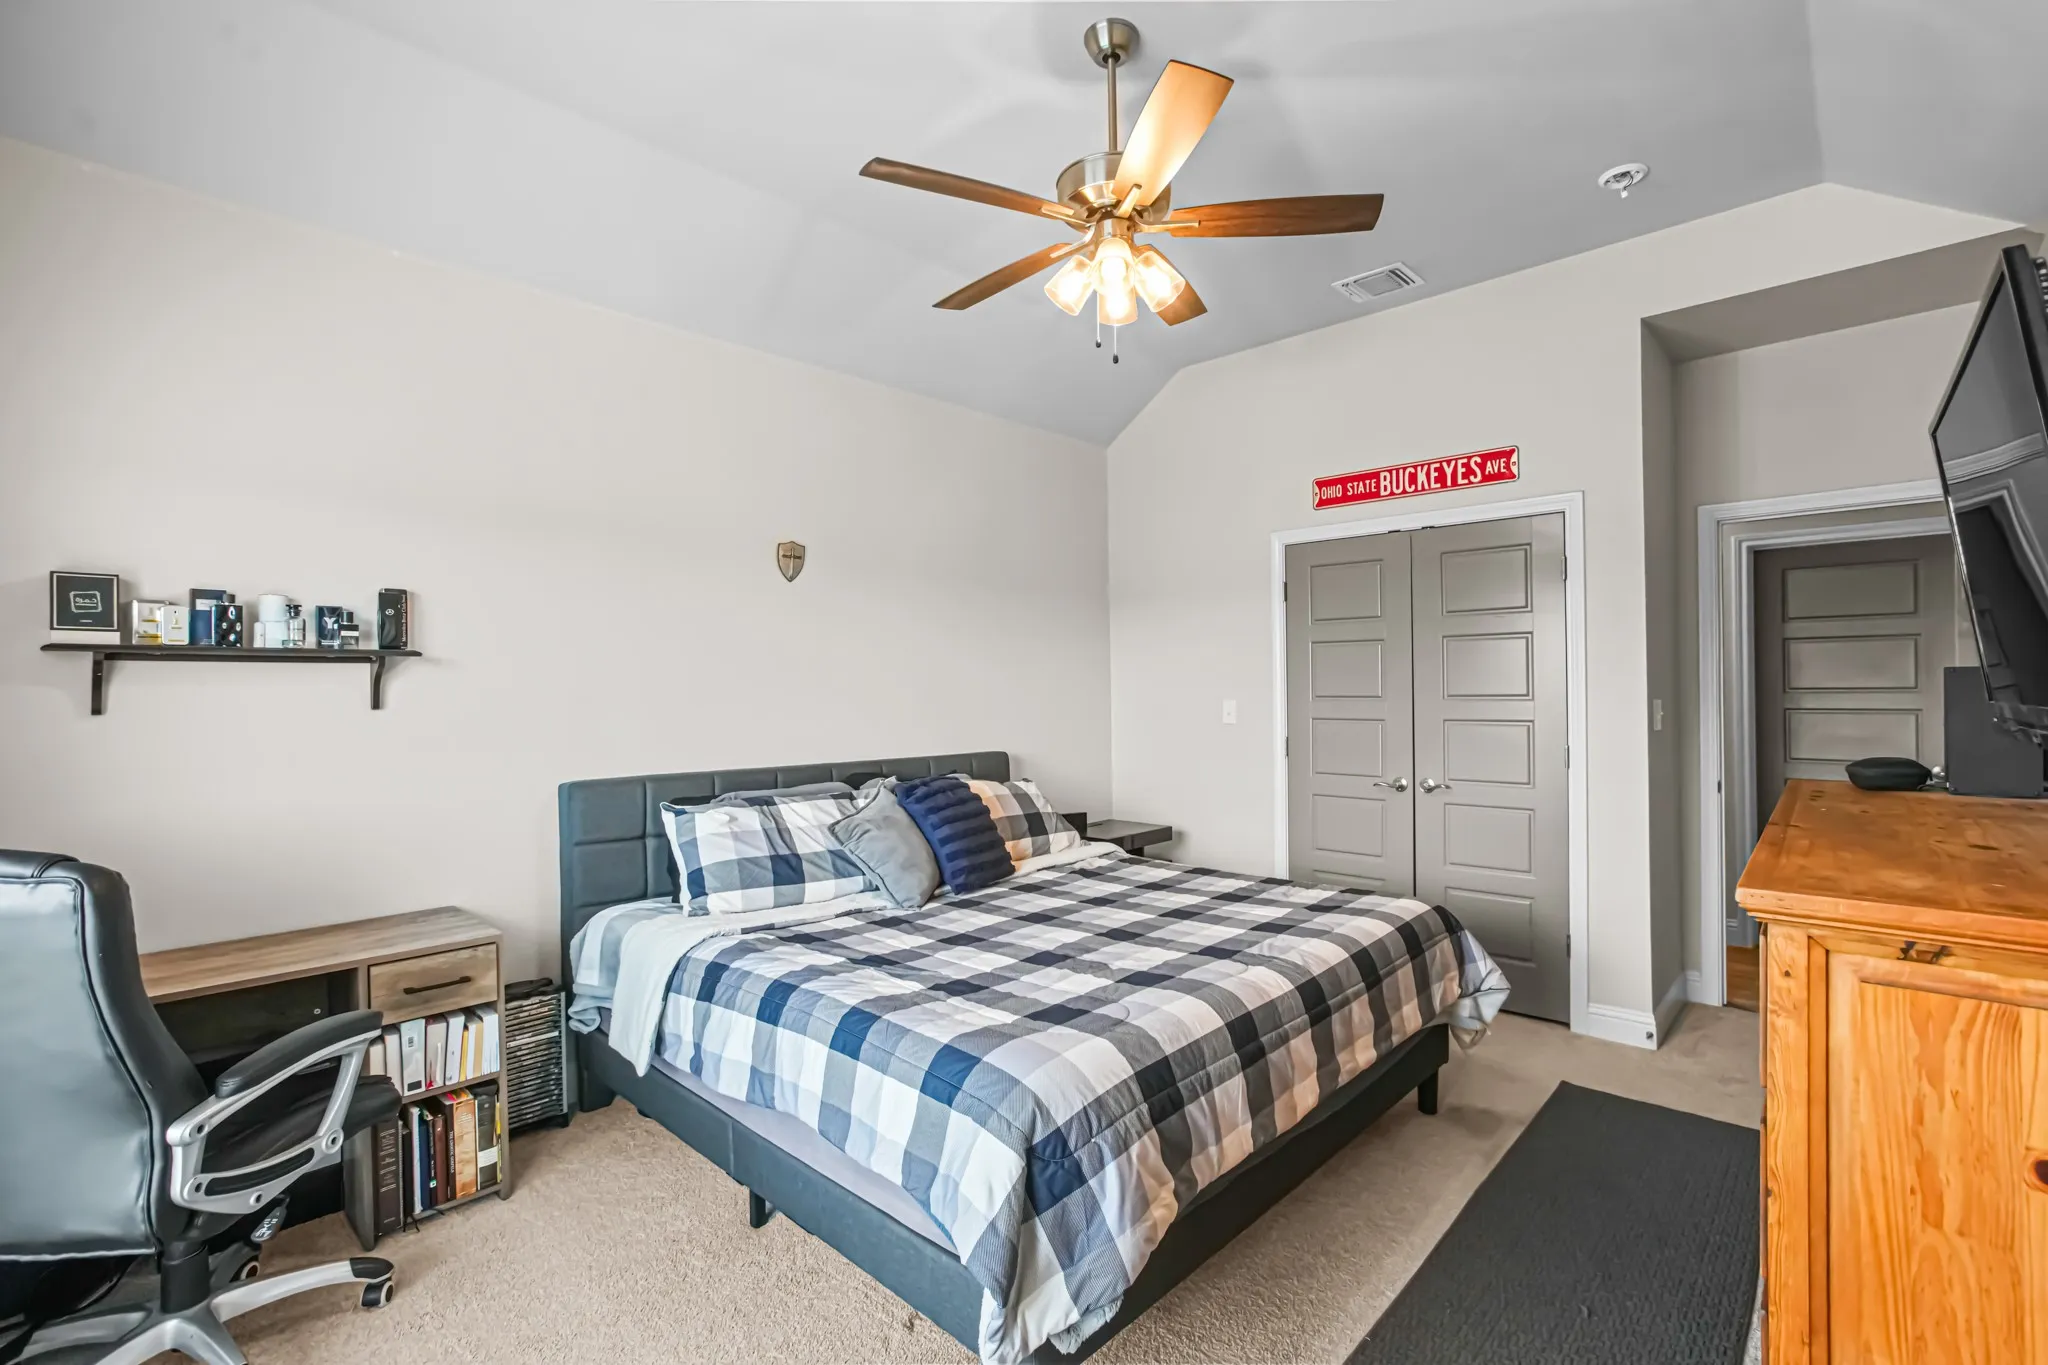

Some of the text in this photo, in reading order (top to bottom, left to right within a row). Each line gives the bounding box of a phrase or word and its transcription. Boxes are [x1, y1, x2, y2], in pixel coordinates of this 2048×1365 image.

[1321, 456, 1507, 500] OHIO STATE BUCKEYES AVE
